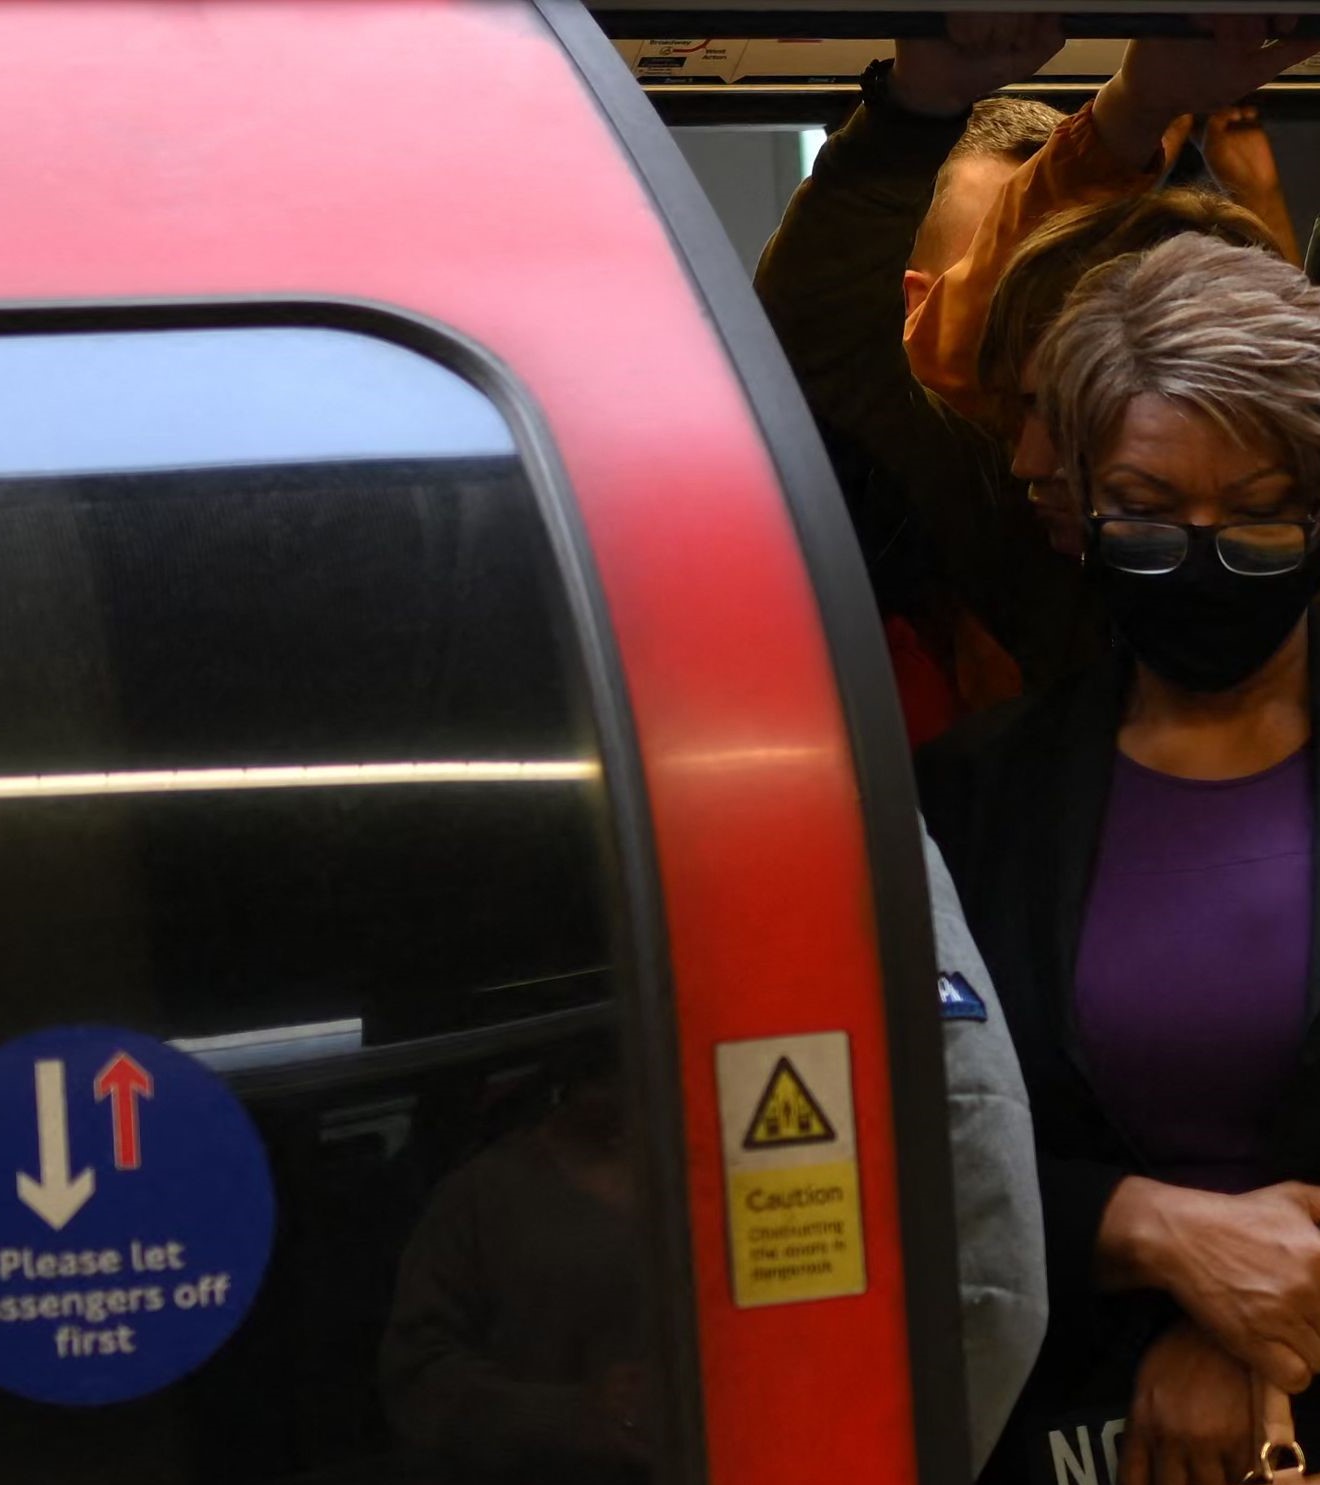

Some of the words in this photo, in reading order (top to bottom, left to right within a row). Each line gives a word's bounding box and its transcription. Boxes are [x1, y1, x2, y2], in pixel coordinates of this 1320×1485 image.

[746, 1184, 844, 1212] Caution
[1, 1248, 122, 1281] Please
[131, 1241, 186, 1272] let
[0, 1286, 165, 1322] ssengers
[173, 1273, 231, 1309] off
[54, 1325, 136, 1358] first
